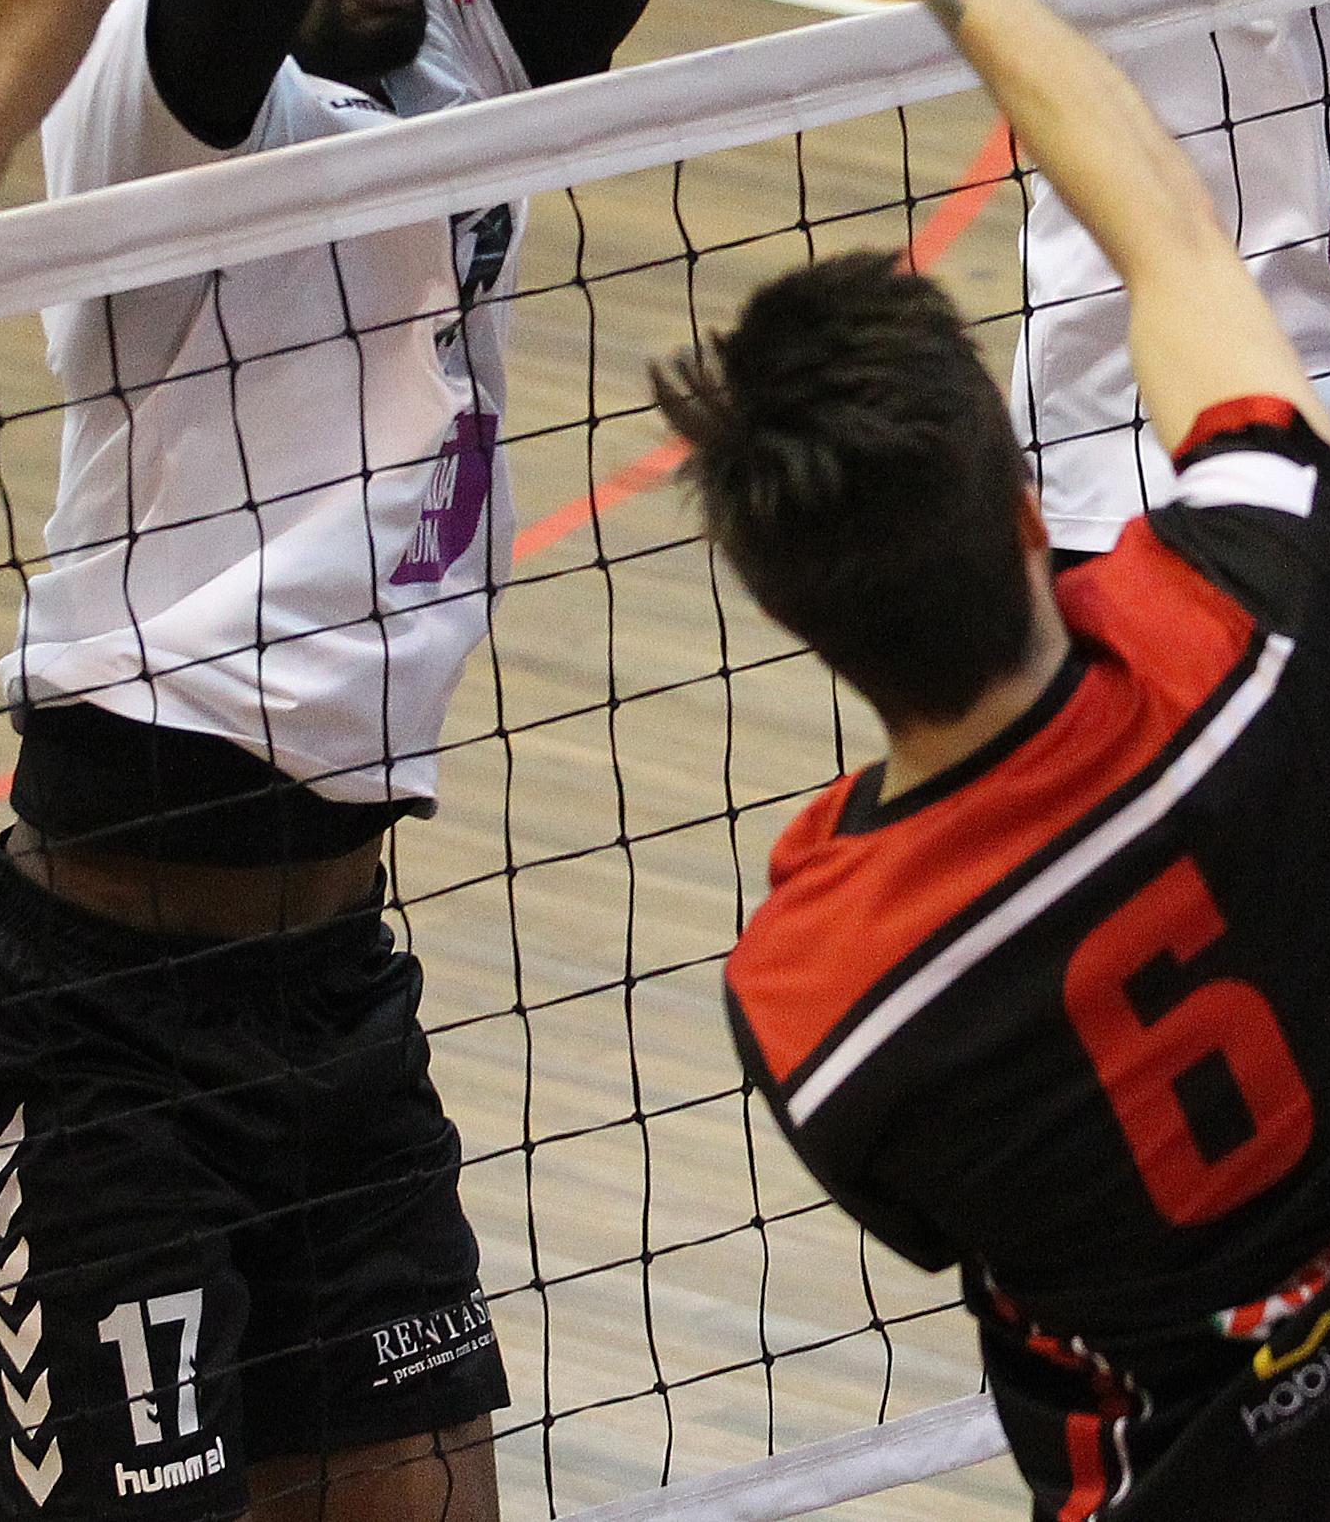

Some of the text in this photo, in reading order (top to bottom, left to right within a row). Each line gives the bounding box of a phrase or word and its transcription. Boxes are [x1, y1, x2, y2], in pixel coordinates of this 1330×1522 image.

[1063, 854, 1316, 1228] 6
[97, 1288, 204, 1447] 17
[114, 1435, 226, 1498] hummel
